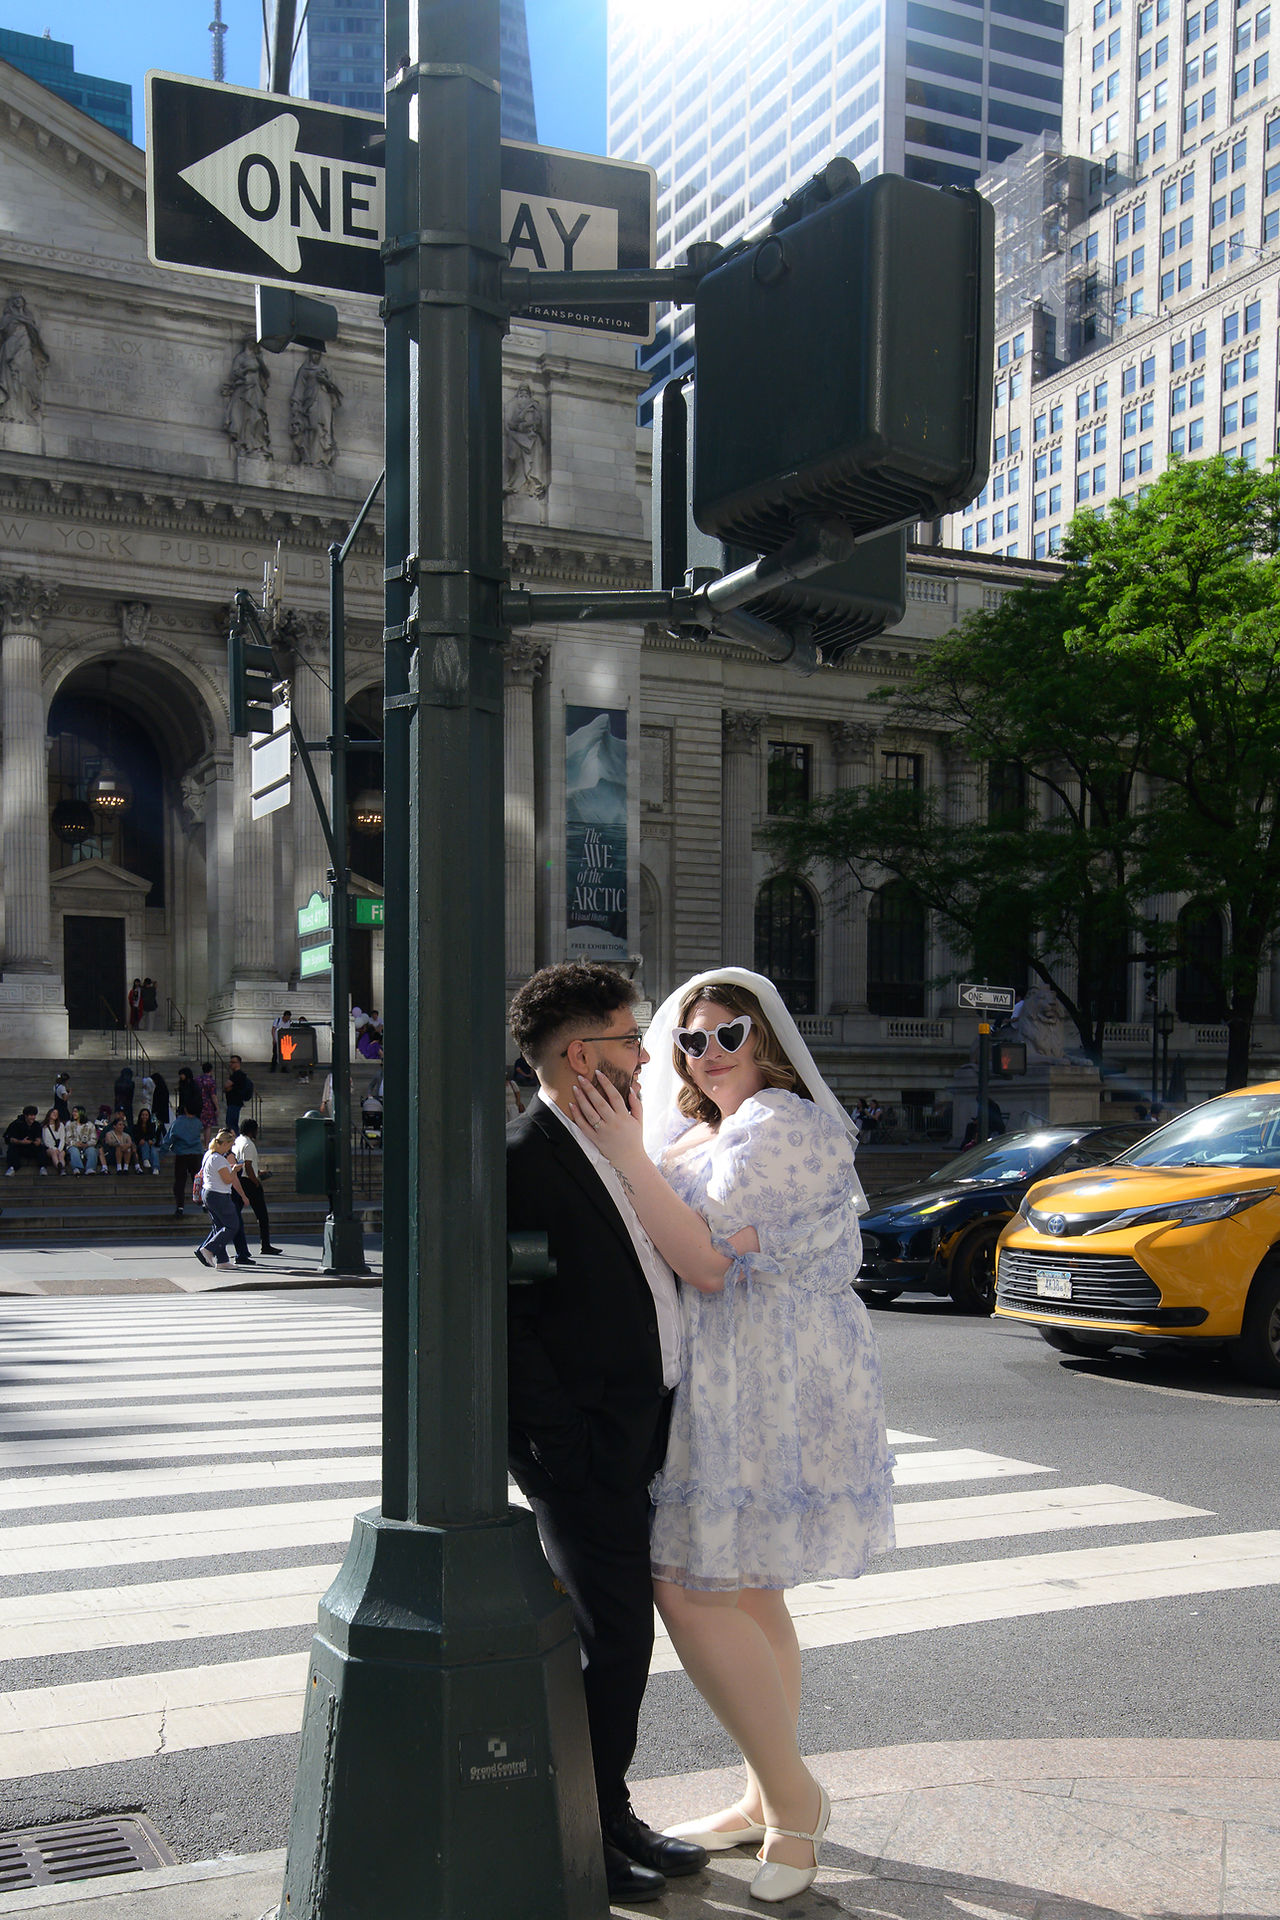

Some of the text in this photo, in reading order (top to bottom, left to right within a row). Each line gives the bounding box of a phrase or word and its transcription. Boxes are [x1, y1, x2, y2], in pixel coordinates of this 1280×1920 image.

[238, 153, 591, 272] ONE AY
[529, 306, 631, 328] TRANSPORTATION
[57, 527, 132, 556] YORK
[160, 540, 258, 571] PUBLIC
[286, 555, 384, 586] LIBAR
[585, 827, 602, 843] The
[581, 843, 613, 868] AWE
[577, 868, 604, 886] of the
[572, 886, 626, 913] ARCTIC
[371, 905, 384, 920] Fi
[587, 943, 624, 951] EXHIBITION
[968, 992, 1009, 1003] ONE WAY
[470, 1758, 527, 1775] Grand Central
